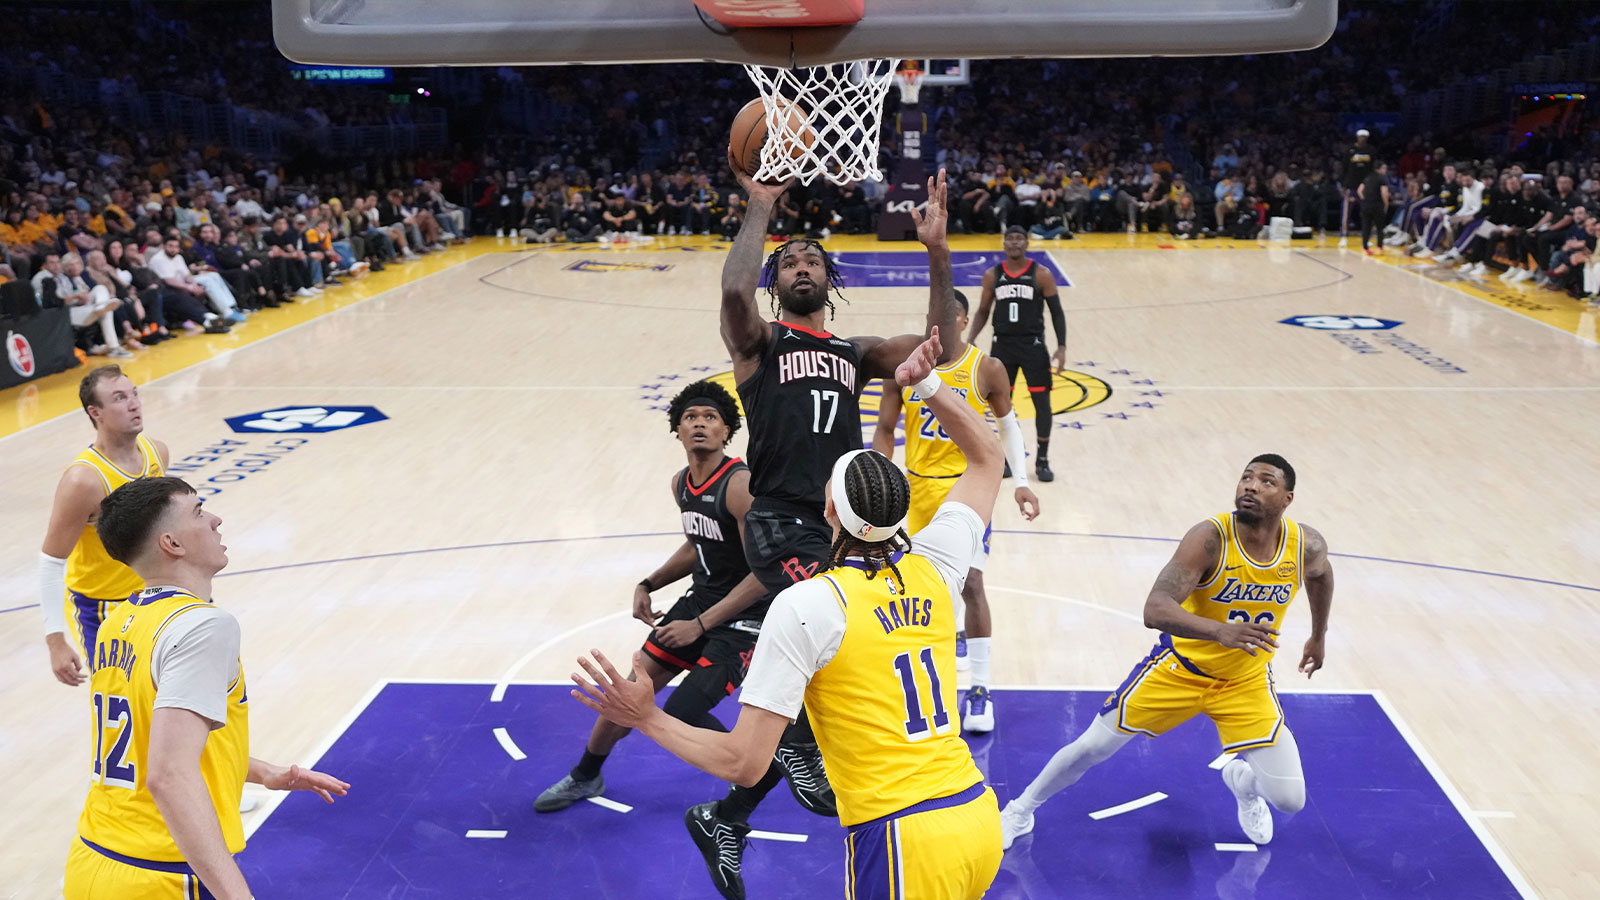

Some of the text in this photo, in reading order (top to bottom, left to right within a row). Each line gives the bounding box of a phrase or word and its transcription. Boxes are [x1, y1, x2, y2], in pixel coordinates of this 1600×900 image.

[342, 68, 386, 79] EXPRESS
[995, 284, 1034, 301] HOUSTON
[1009, 302, 1019, 323] 0
[778, 350, 857, 396] HOUSTON
[810, 389, 840, 434] 17
[197, 437, 309, 502] crypto.c
[681, 511, 724, 542] OUSTON
[695, 543, 711, 576] 1
[1209, 577, 1293, 605] LAKERS
[873, 597, 933, 635] HAYES
[893, 645, 952, 743] 11
[87, 691, 137, 791] 12
